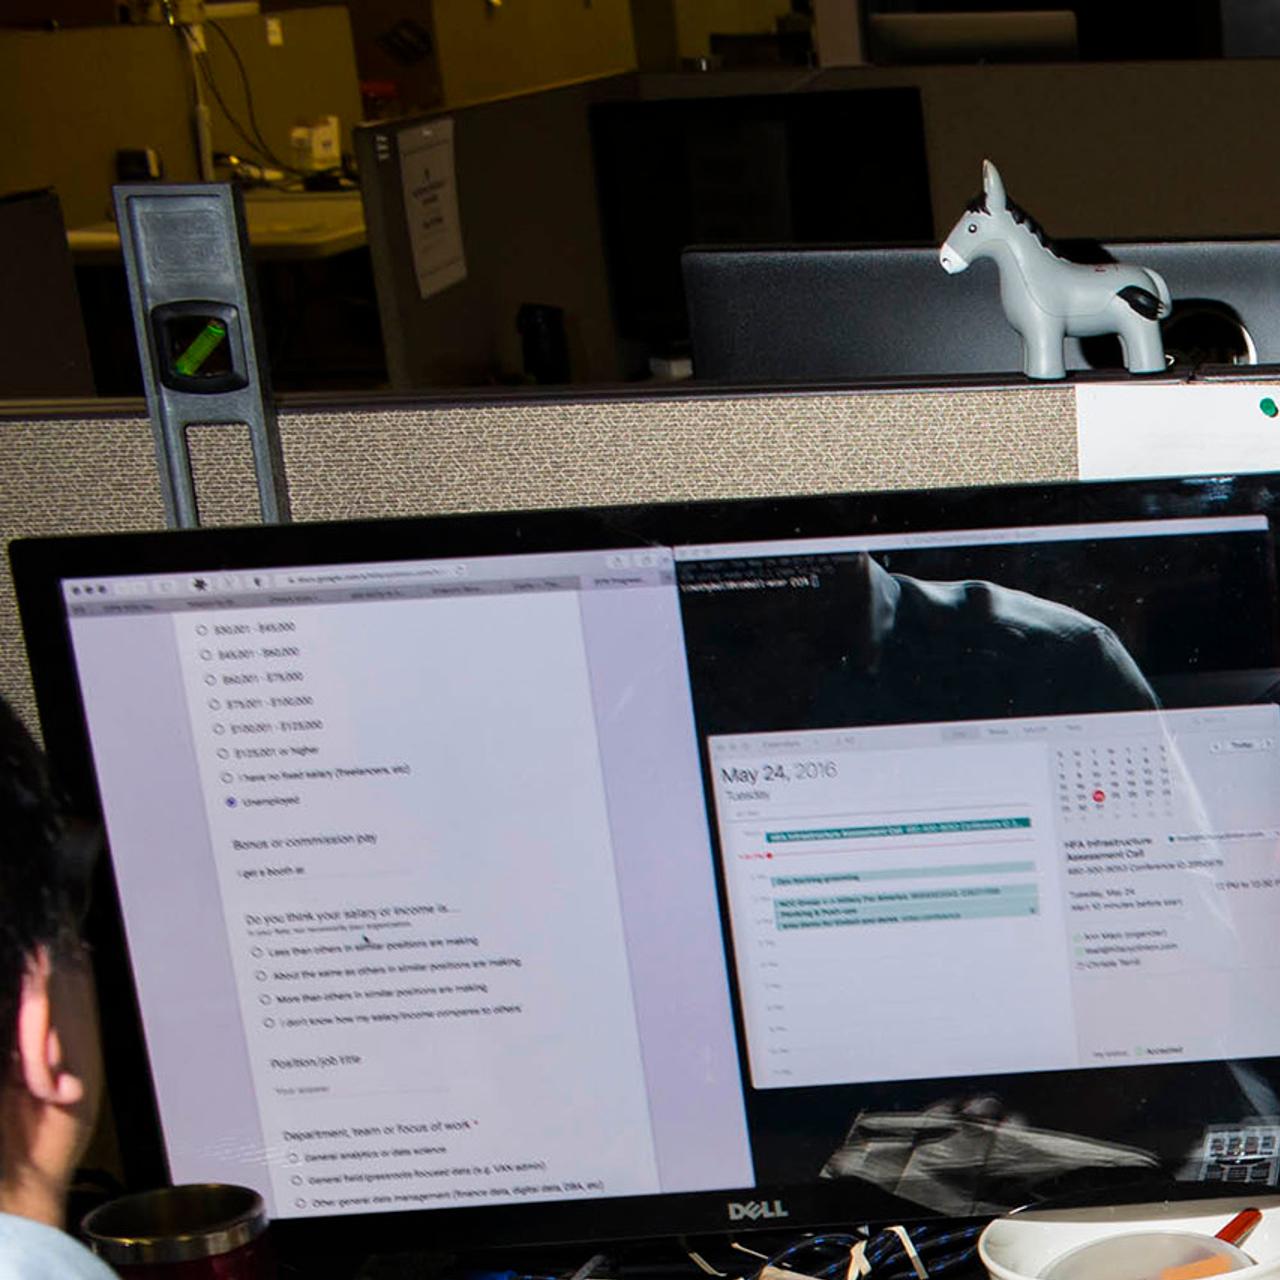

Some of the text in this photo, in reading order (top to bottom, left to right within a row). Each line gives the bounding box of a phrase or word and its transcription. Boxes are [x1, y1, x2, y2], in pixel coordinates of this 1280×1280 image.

[720, 760, 839, 785] May 24, 2016
[242, 795, 301, 808] Unemployed
[232, 839, 268, 851] Bonus
[285, 835, 354, 848] commission
[357, 834, 378, 846] pay
[264, 914, 285, 926] you
[286, 912, 314, 922] think
[316, 912, 341, 923] your
[344, 909, 377, 920] salary
[394, 905, 434, 915] income
[386, 941, 428, 951] positions
[446, 937, 479, 947] making
[430, 962, 470, 972] positions
[488, 958, 522, 968] making
[396, 987, 437, 997] positions
[455, 983, 488, 993] making
[270, 1054, 362, 1070] Position/job title
[283, 1128, 351, 1142] Department,
[352, 1126, 382, 1137] team
[397, 1123, 429, 1134] focus
[444, 1120, 470, 1131] work
[728, 1200, 789, 1220] DELL
